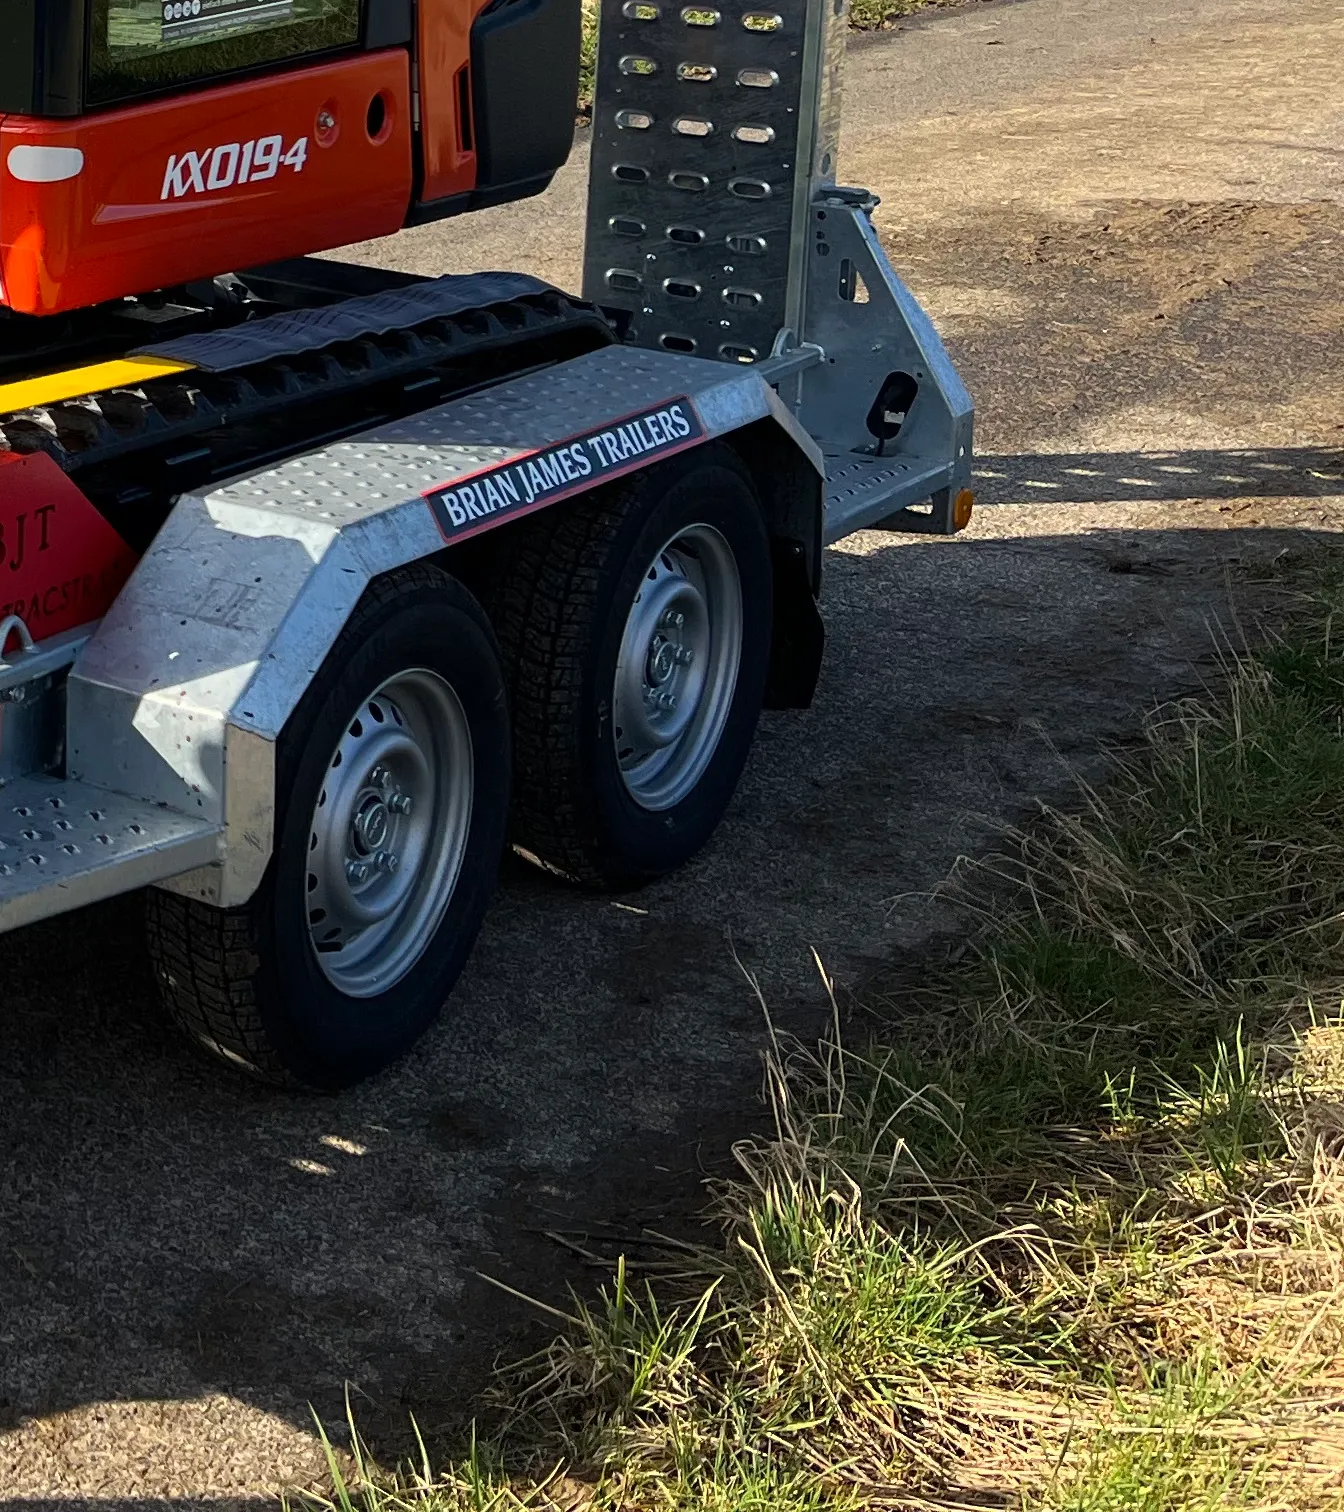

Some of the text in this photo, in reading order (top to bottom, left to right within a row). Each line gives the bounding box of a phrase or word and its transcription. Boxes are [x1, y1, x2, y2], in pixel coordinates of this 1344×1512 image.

[160, 134, 308, 200] KX019-4
[441, 405, 691, 526] BRIAN JAMES TRAILERS
